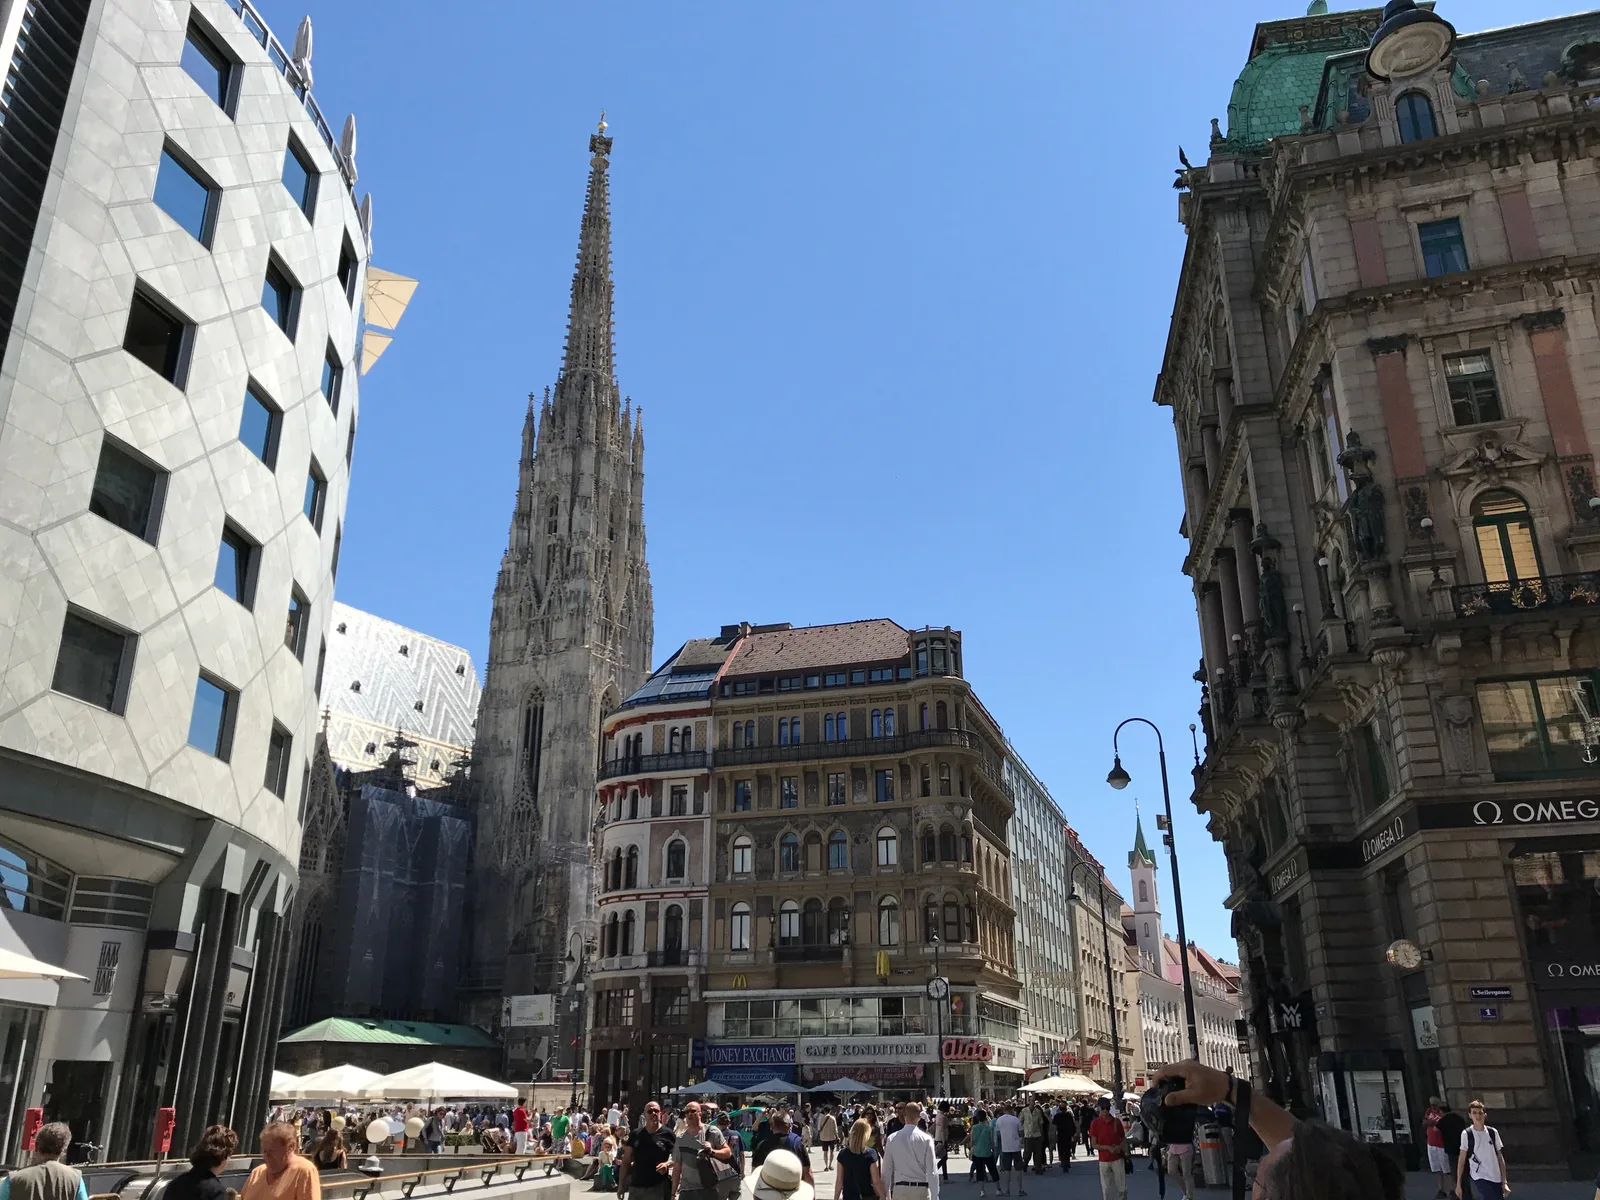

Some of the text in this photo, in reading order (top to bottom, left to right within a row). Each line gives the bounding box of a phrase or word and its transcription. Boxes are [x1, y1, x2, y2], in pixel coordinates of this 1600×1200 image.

[1371, 827, 1395, 855] OMEGA
[706, 1048, 740, 1062] MONEY
[743, 1047, 795, 1062] EXCHANGE
[841, 1043, 927, 1055] KONDITOREI
